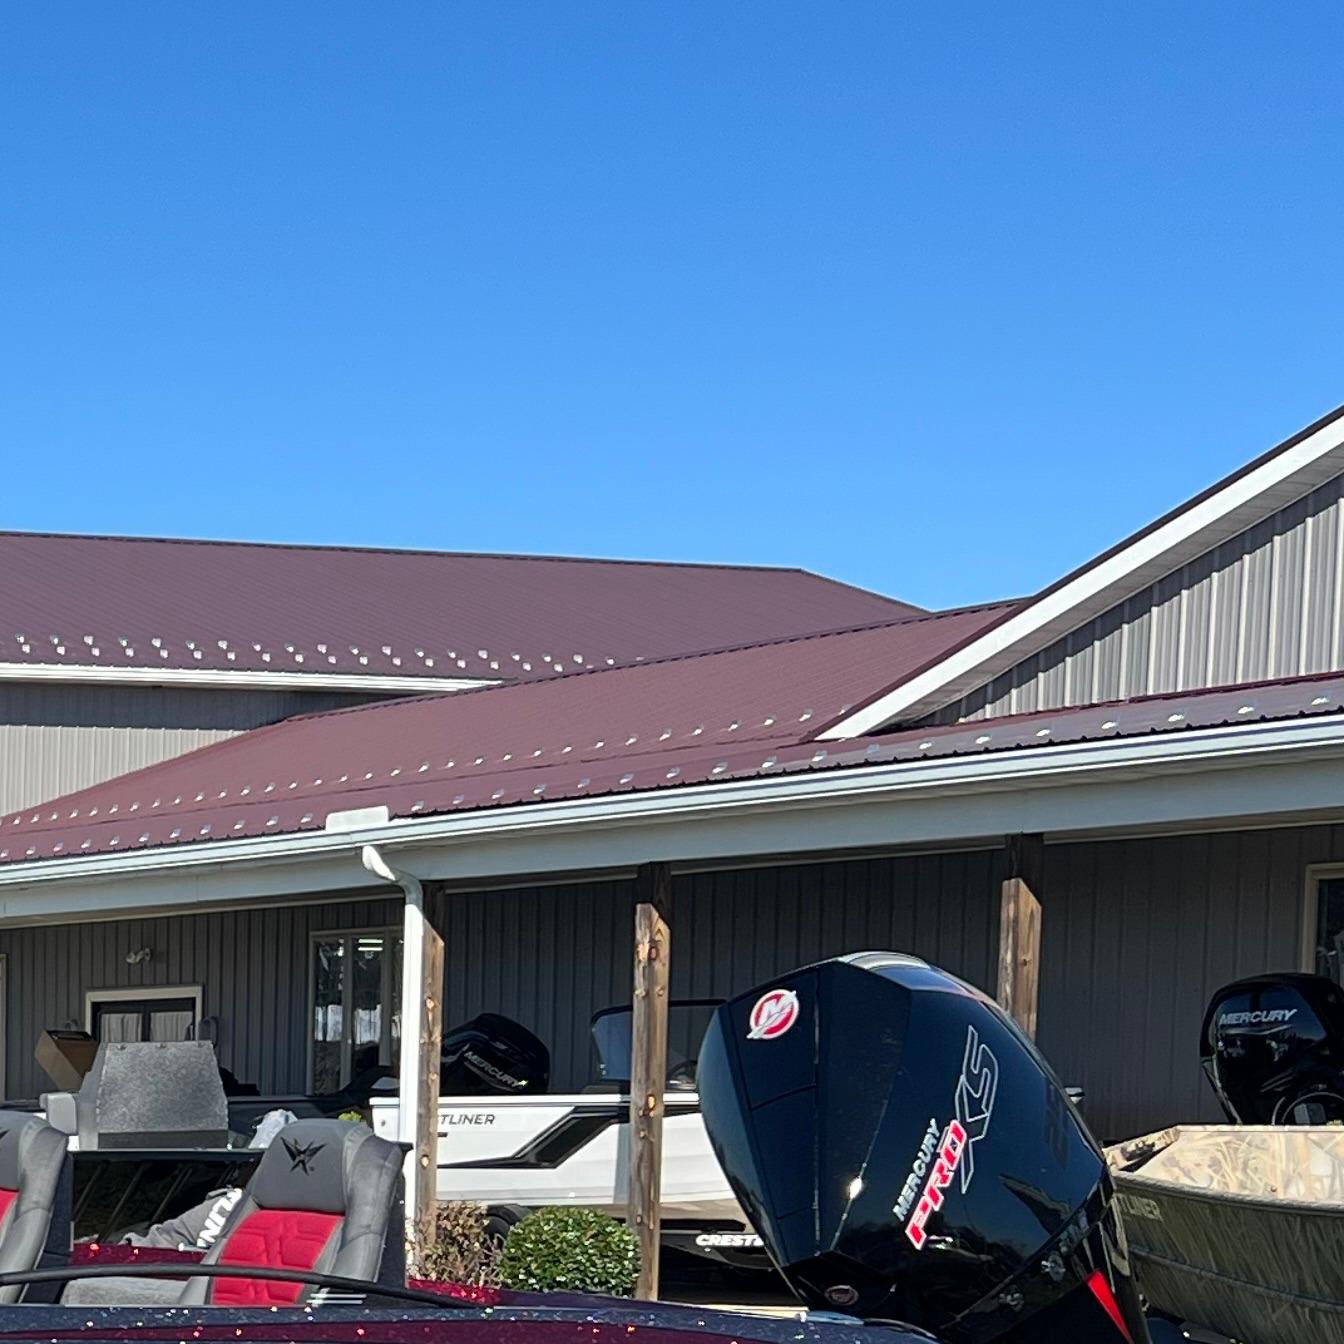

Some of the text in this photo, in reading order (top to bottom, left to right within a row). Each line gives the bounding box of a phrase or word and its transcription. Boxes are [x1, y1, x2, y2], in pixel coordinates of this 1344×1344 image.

[1219, 1008, 1298, 1025] MERCURY
[437, 1113, 496, 1126] TLINER
[893, 1118, 940, 1222] MERCURY
[905, 1119, 967, 1250] PRO
